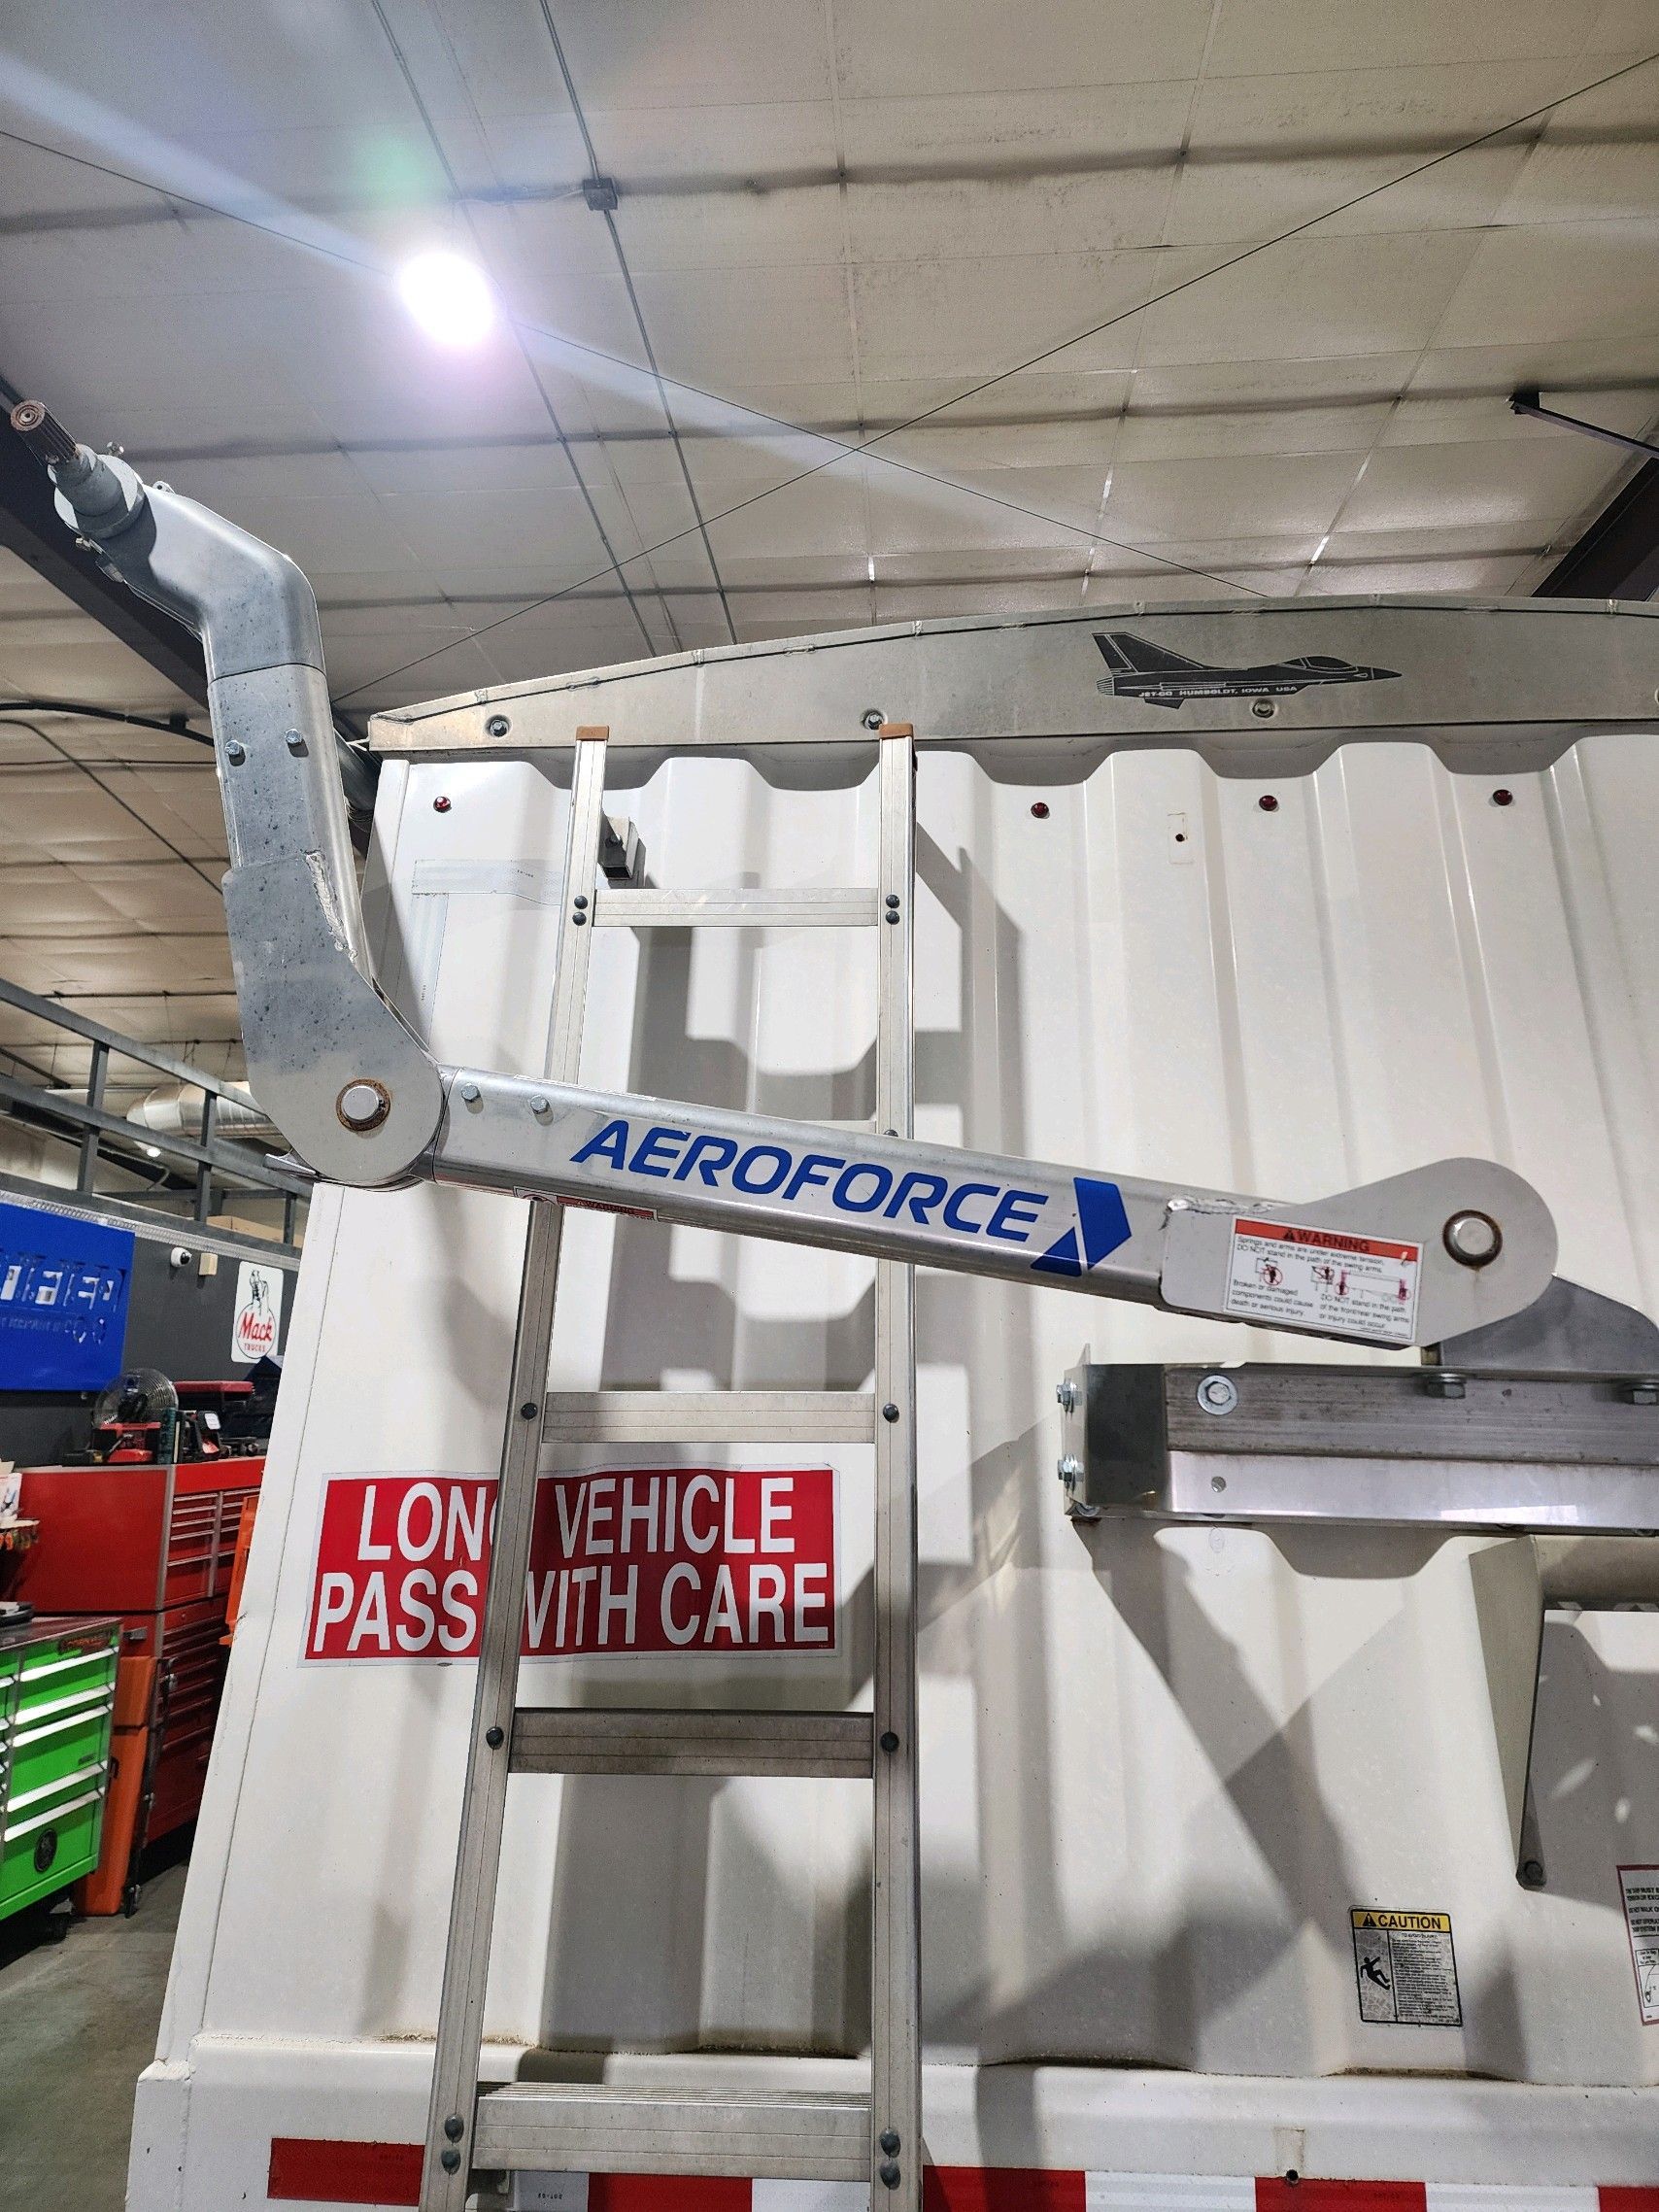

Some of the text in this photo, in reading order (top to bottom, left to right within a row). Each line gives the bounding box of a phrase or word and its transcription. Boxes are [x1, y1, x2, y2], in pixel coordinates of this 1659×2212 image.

[1178, 688, 1238, 697] HUMBOLDT,
[569, 1119, 1048, 1243] AEROFORCE
[1300, 1232, 1371, 1252] WARNING
[238, 1311, 272, 1341] Mack
[357, 1475, 796, 1562] LON VEHICLE
[313, 1569, 480, 1652] PASS
[660, 1561, 830, 1645] CARE
[1377, 1914, 1441, 1929] CAUTION
